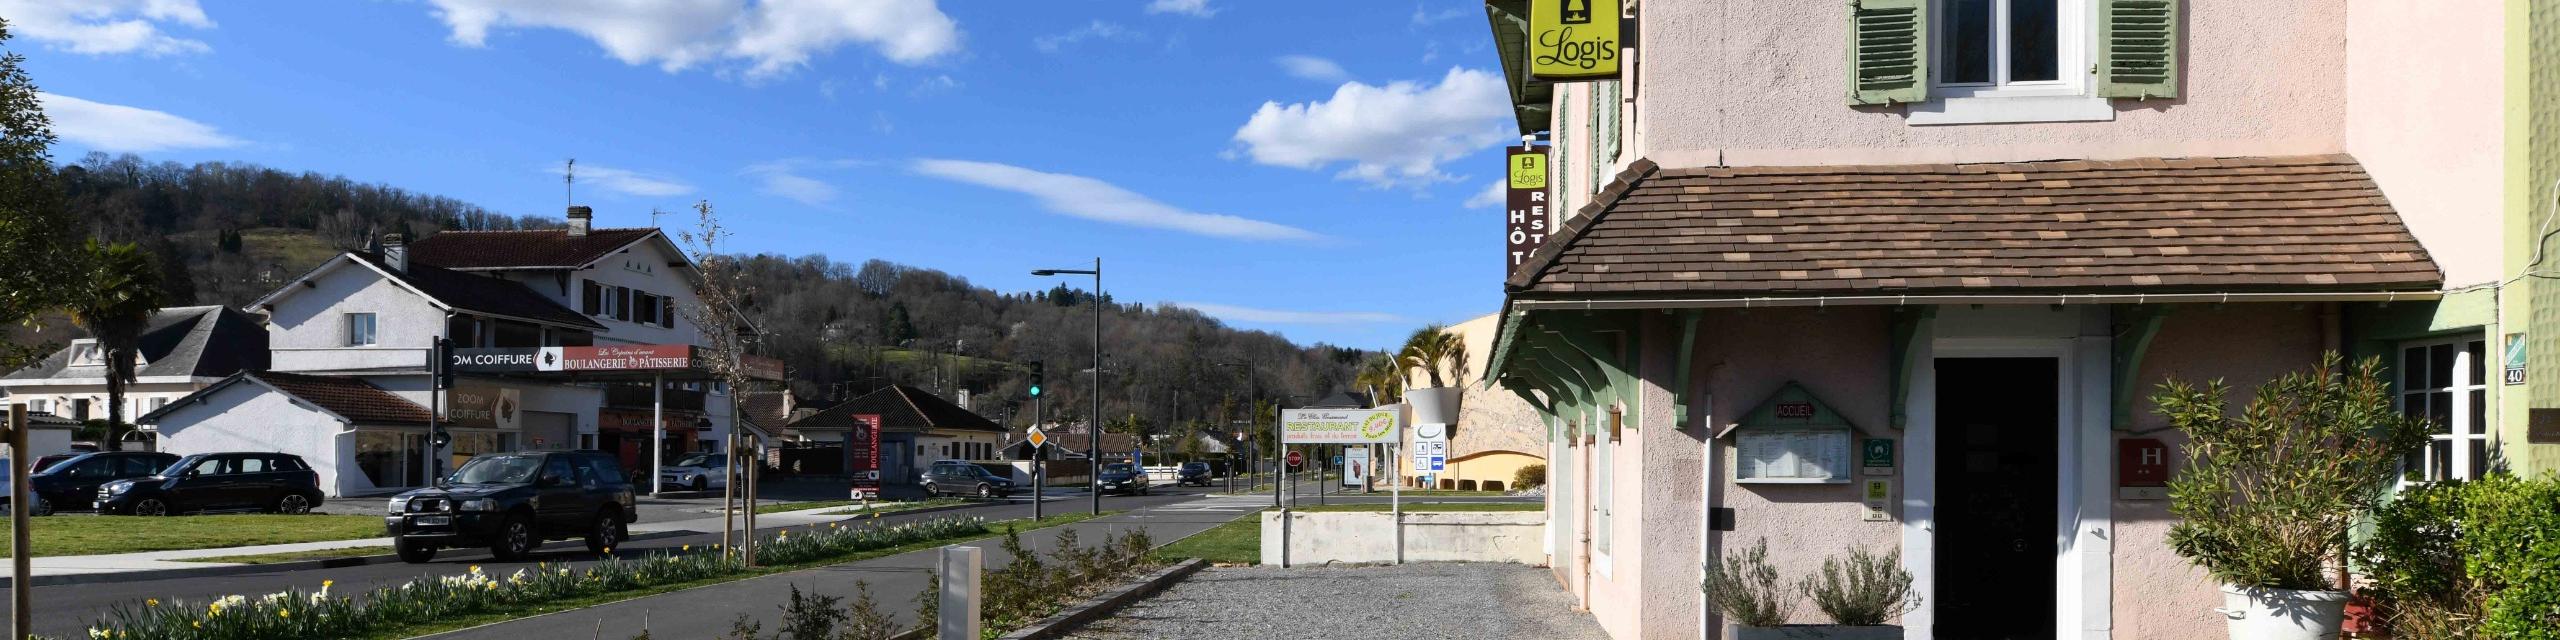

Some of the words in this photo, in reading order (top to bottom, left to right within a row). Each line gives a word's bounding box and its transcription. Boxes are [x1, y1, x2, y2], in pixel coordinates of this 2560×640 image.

[1537, 27, 1615, 69] Logis
[1513, 169, 1544, 187] Logis
[1510, 210, 1526, 266] HÔT
[475, 354, 532, 365] COIFFURE
[564, 358, 627, 369] BOULANGERIE
[639, 355, 688, 368] PÂTISSERIE
[2508, 369, 2523, 382] 40
[457, 393, 484, 405] ZOOM
[450, 408, 491, 420] COIFFURE
[1776, 405, 1813, 416] ACCUEIL
[1286, 421, 1360, 431] RESTAURANT
[870, 417, 878, 469] BOULANGERIE
[2142, 447, 2161, 465] H
